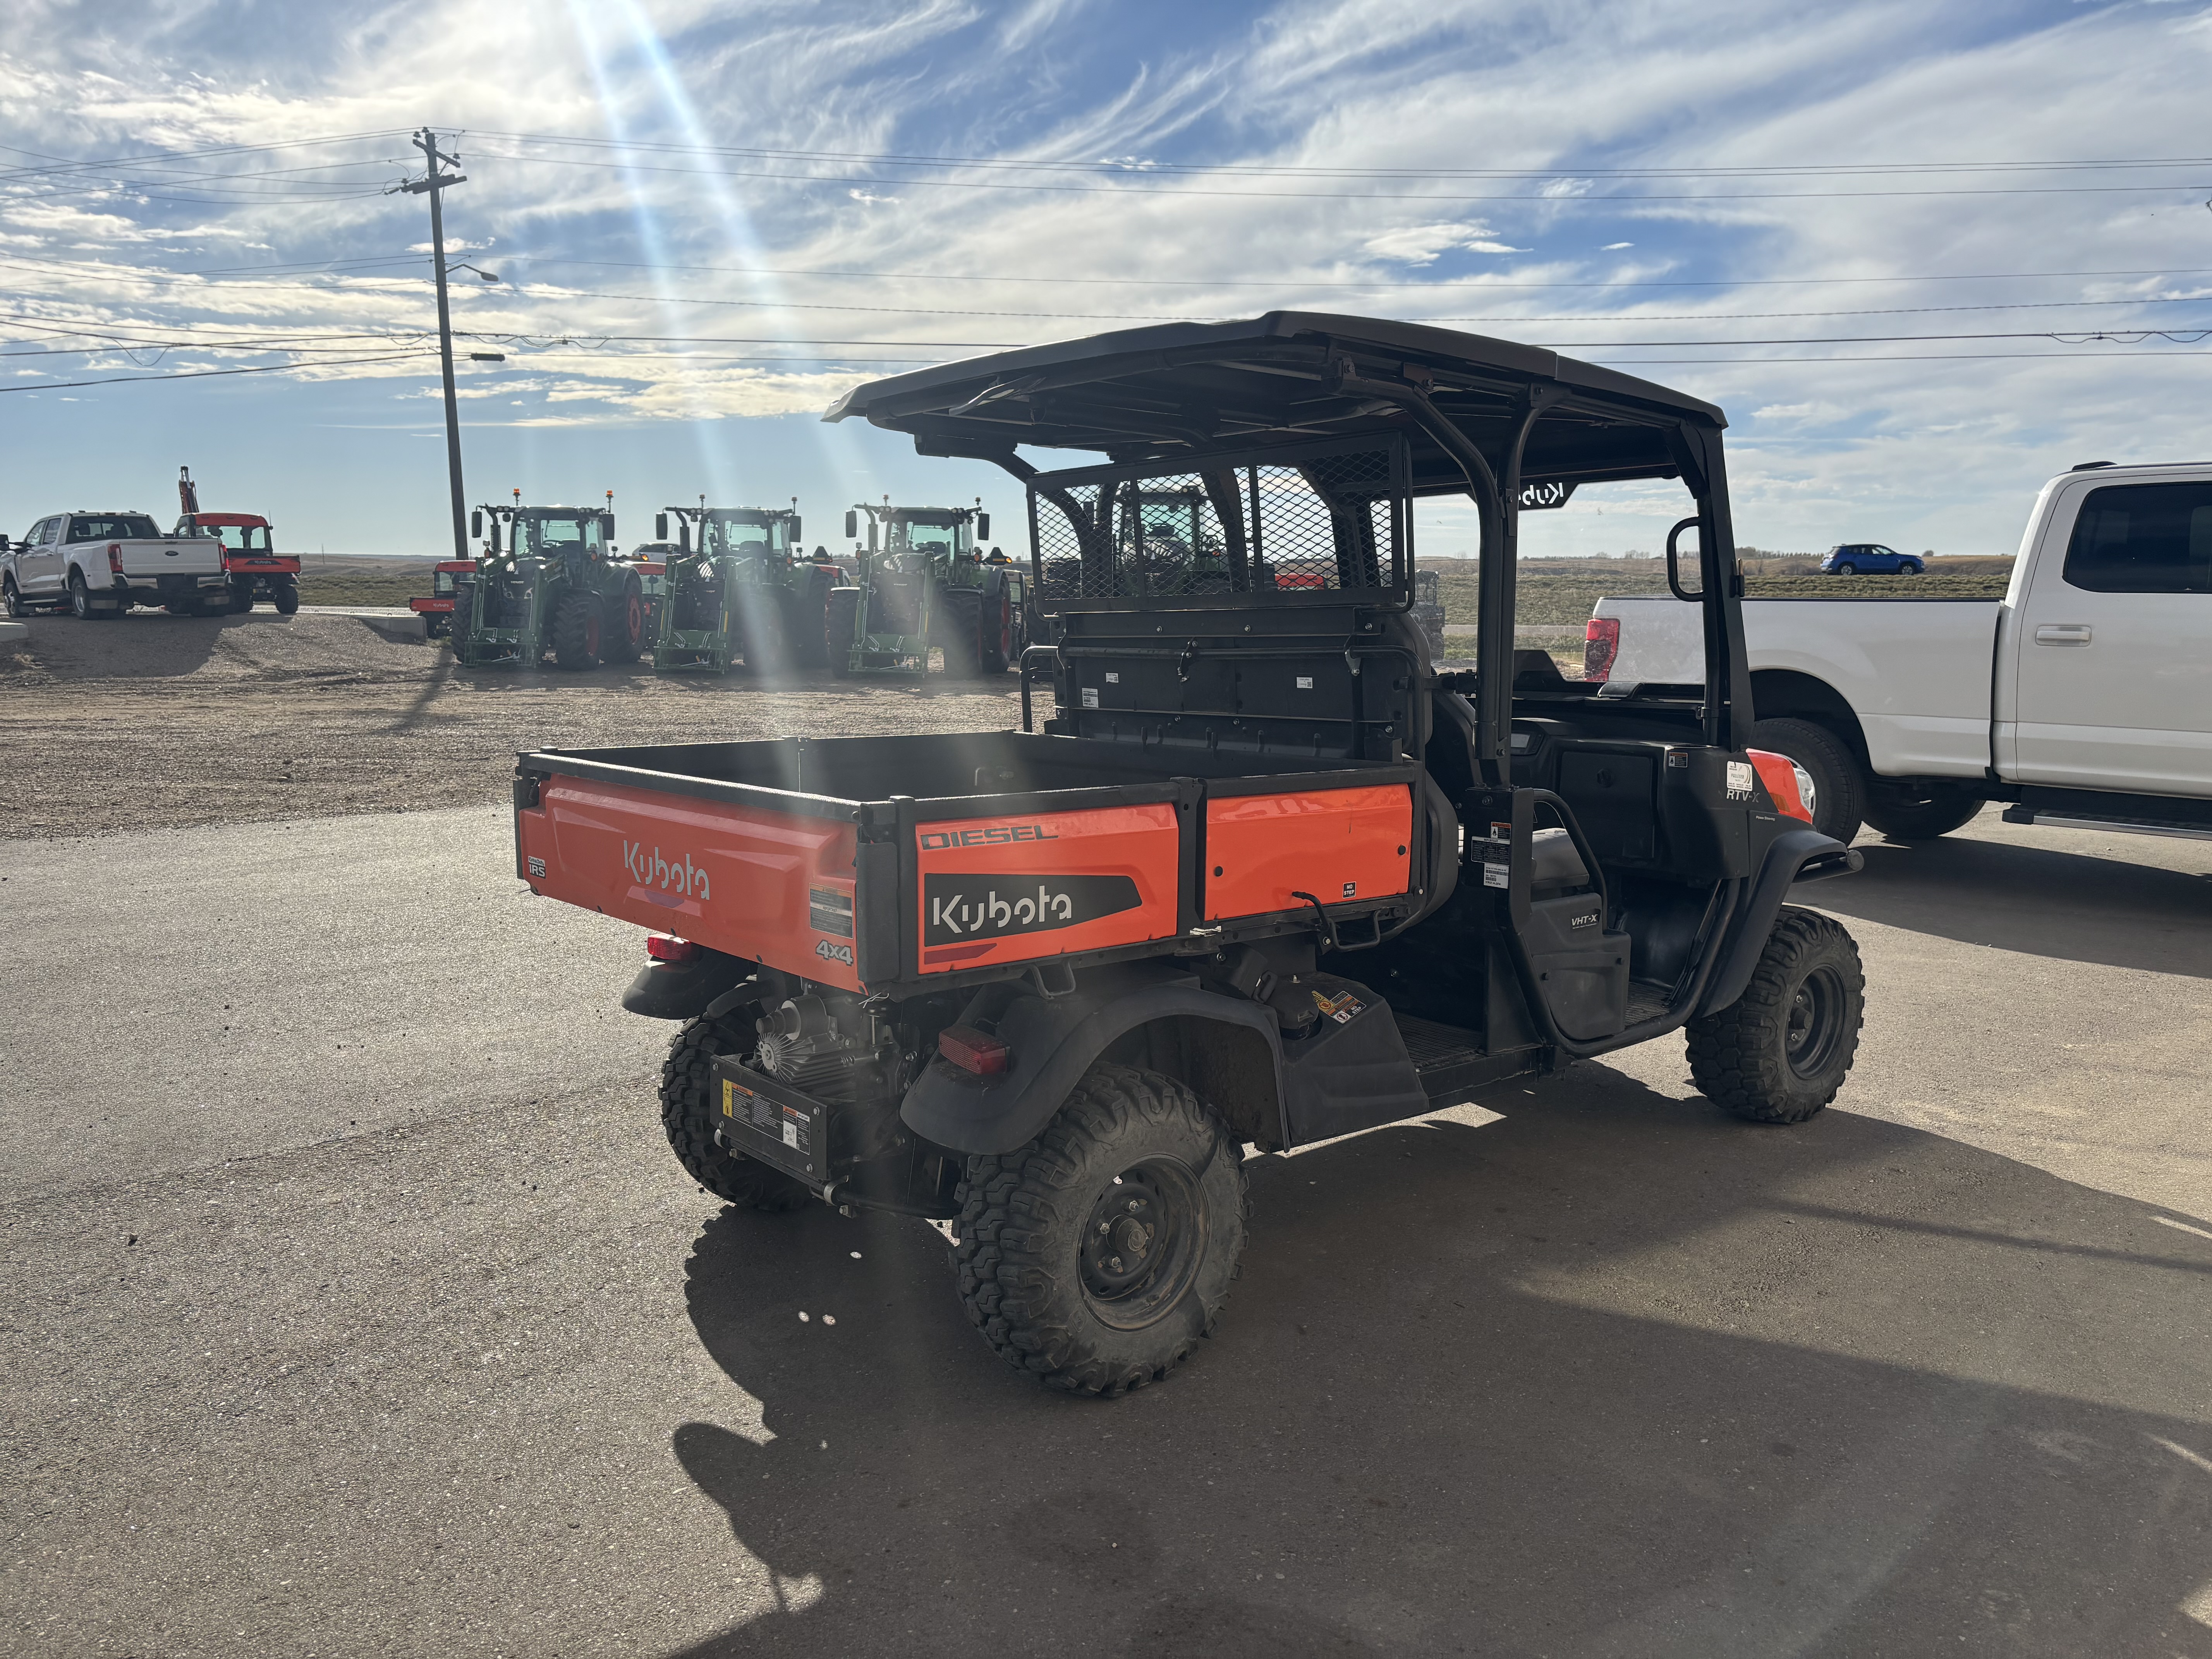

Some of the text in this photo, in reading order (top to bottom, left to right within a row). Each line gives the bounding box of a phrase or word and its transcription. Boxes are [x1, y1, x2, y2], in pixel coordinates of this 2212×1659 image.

[1726, 788, 1760, 803] RTV-X
[920, 824, 1059, 851] DIESEL
[529, 864, 545, 877] IRS
[623, 840, 710, 901] Kubota
[933, 885, 1072, 933] Kubota
[1571, 914, 1598, 926] VHT-X
